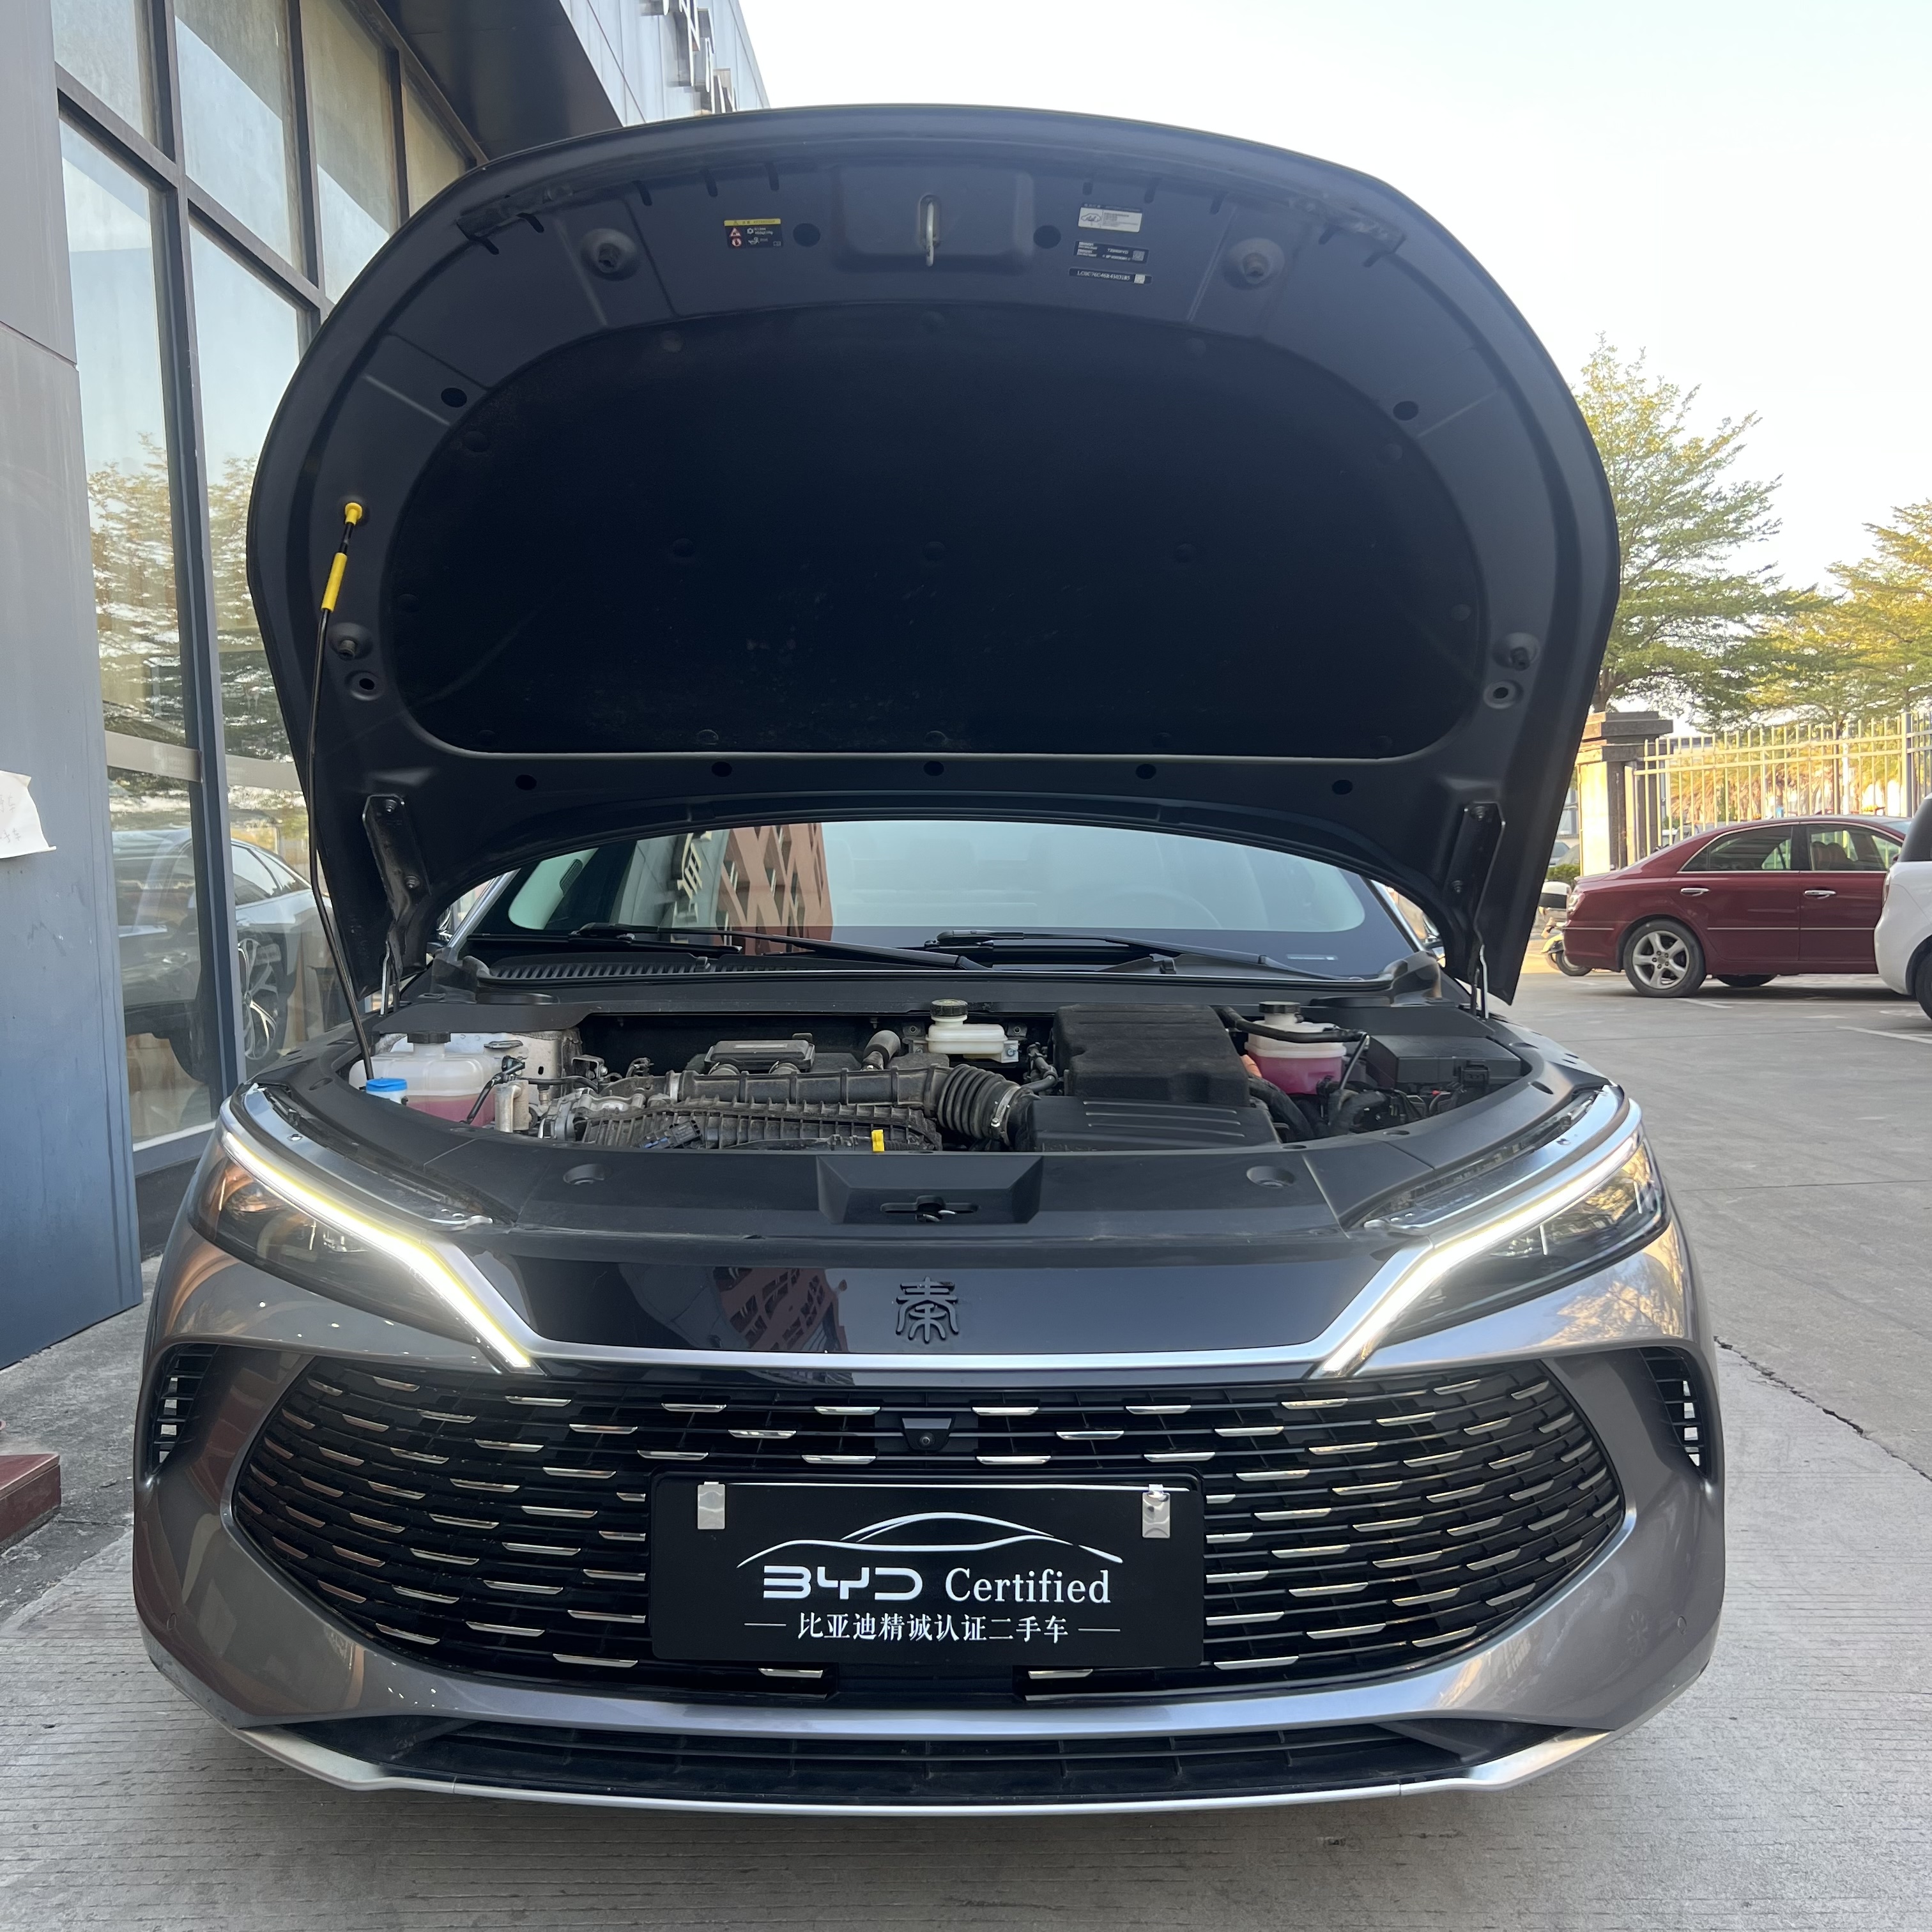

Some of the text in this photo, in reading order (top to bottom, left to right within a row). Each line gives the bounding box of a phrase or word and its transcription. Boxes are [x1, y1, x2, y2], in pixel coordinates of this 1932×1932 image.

[763, 1566, 1111, 1604] BYD Certified
[798, 1612, 1068, 1644] 比亚迪精诚认证二手车
